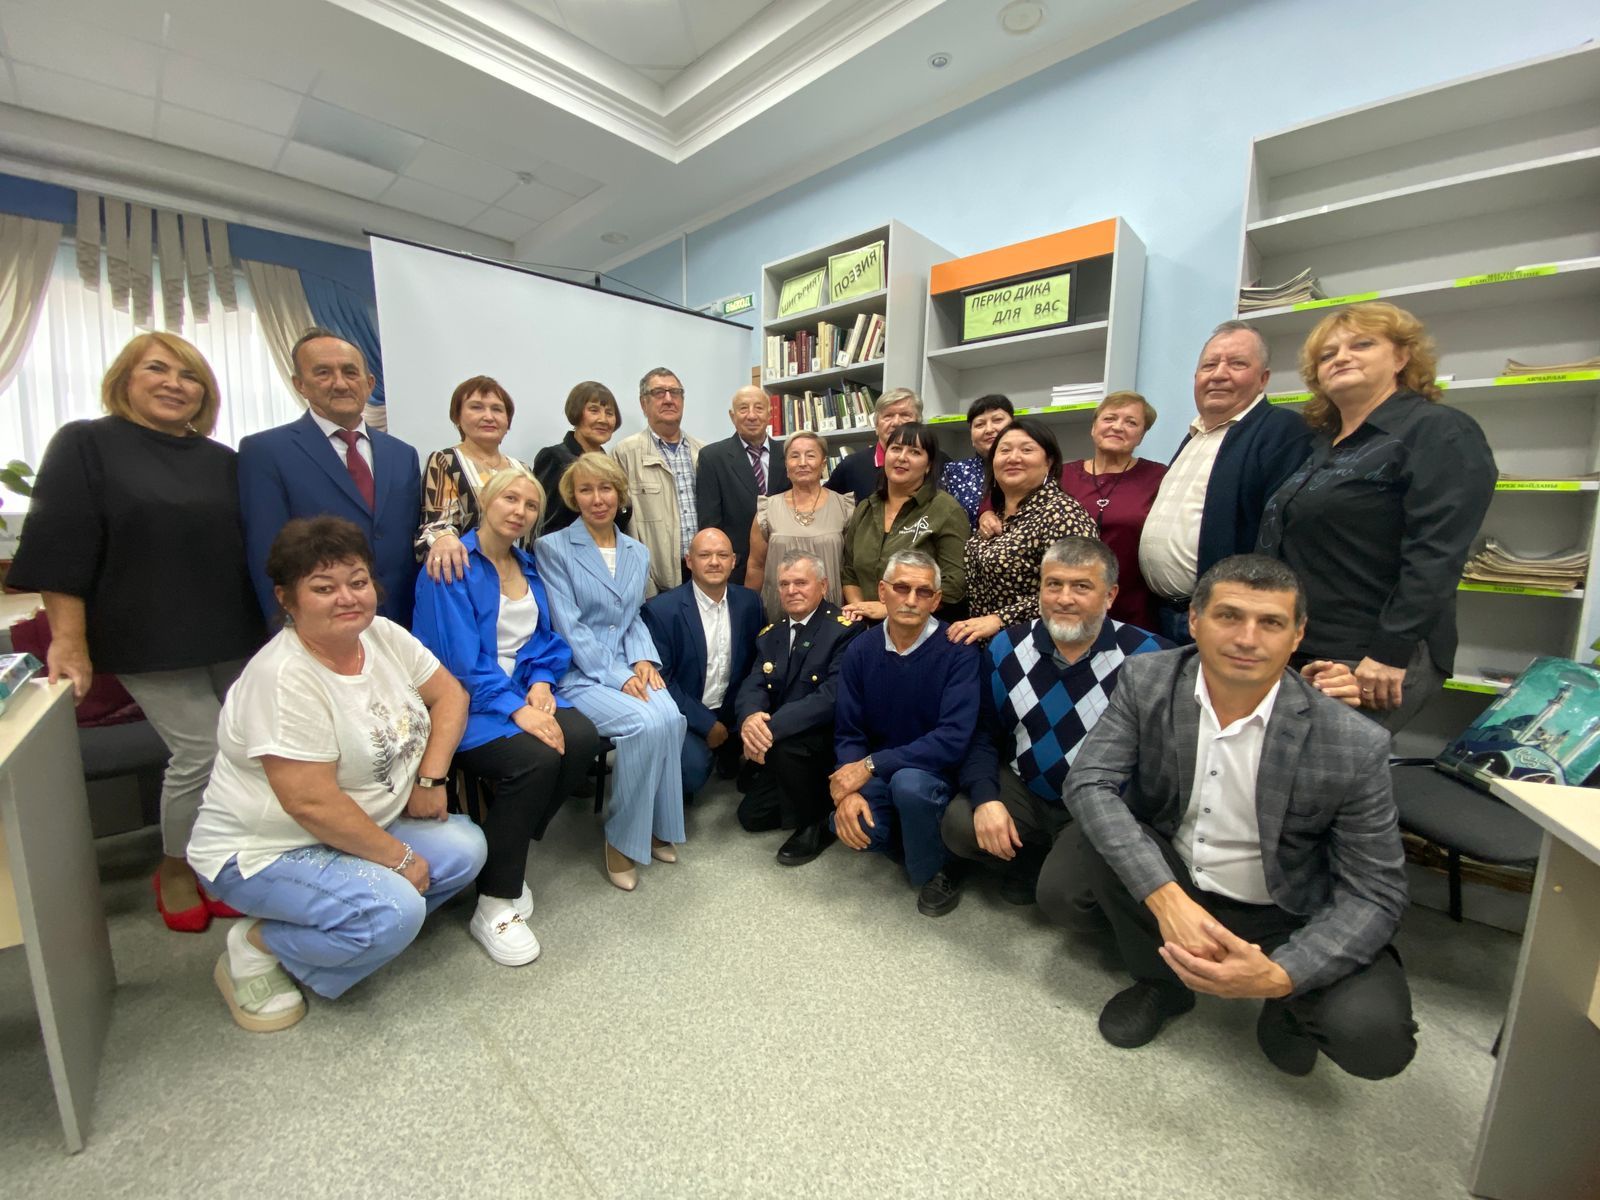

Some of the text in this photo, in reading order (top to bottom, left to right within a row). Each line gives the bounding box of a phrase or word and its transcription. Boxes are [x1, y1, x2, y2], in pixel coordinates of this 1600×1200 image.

[833, 249, 877, 298] ПОЭЗИЯ
[725, 295, 751, 313] ВЫХОД
[992, 299, 1061, 326] ДЛЯ ВАС
